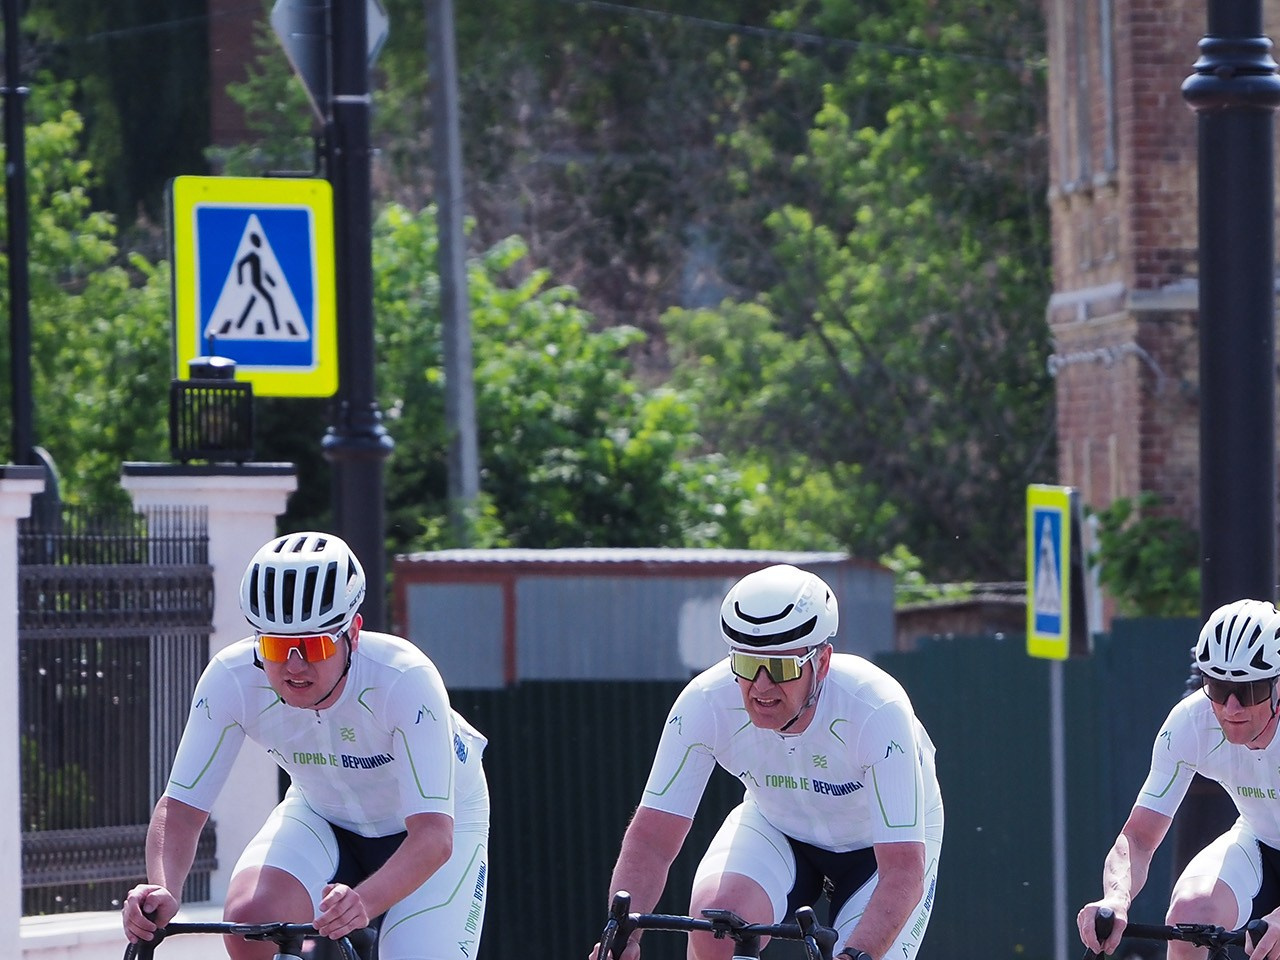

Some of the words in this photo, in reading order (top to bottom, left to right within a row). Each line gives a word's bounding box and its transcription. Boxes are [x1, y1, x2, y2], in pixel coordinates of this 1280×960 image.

[293, 752, 339, 767] ГОРНЫЕ
[341, 752, 395, 770] ВЕРШИНЫ
[766, 775, 810, 791] ГОРНЫЕ
[812, 779, 864, 797] ВЕРШИНЫ
[1237, 786, 1277, 800] ГОРНЫЕ
[465, 900, 481, 935] ГОРНЫЕ
[473, 860, 486, 902] ВЕРШИНЫ
